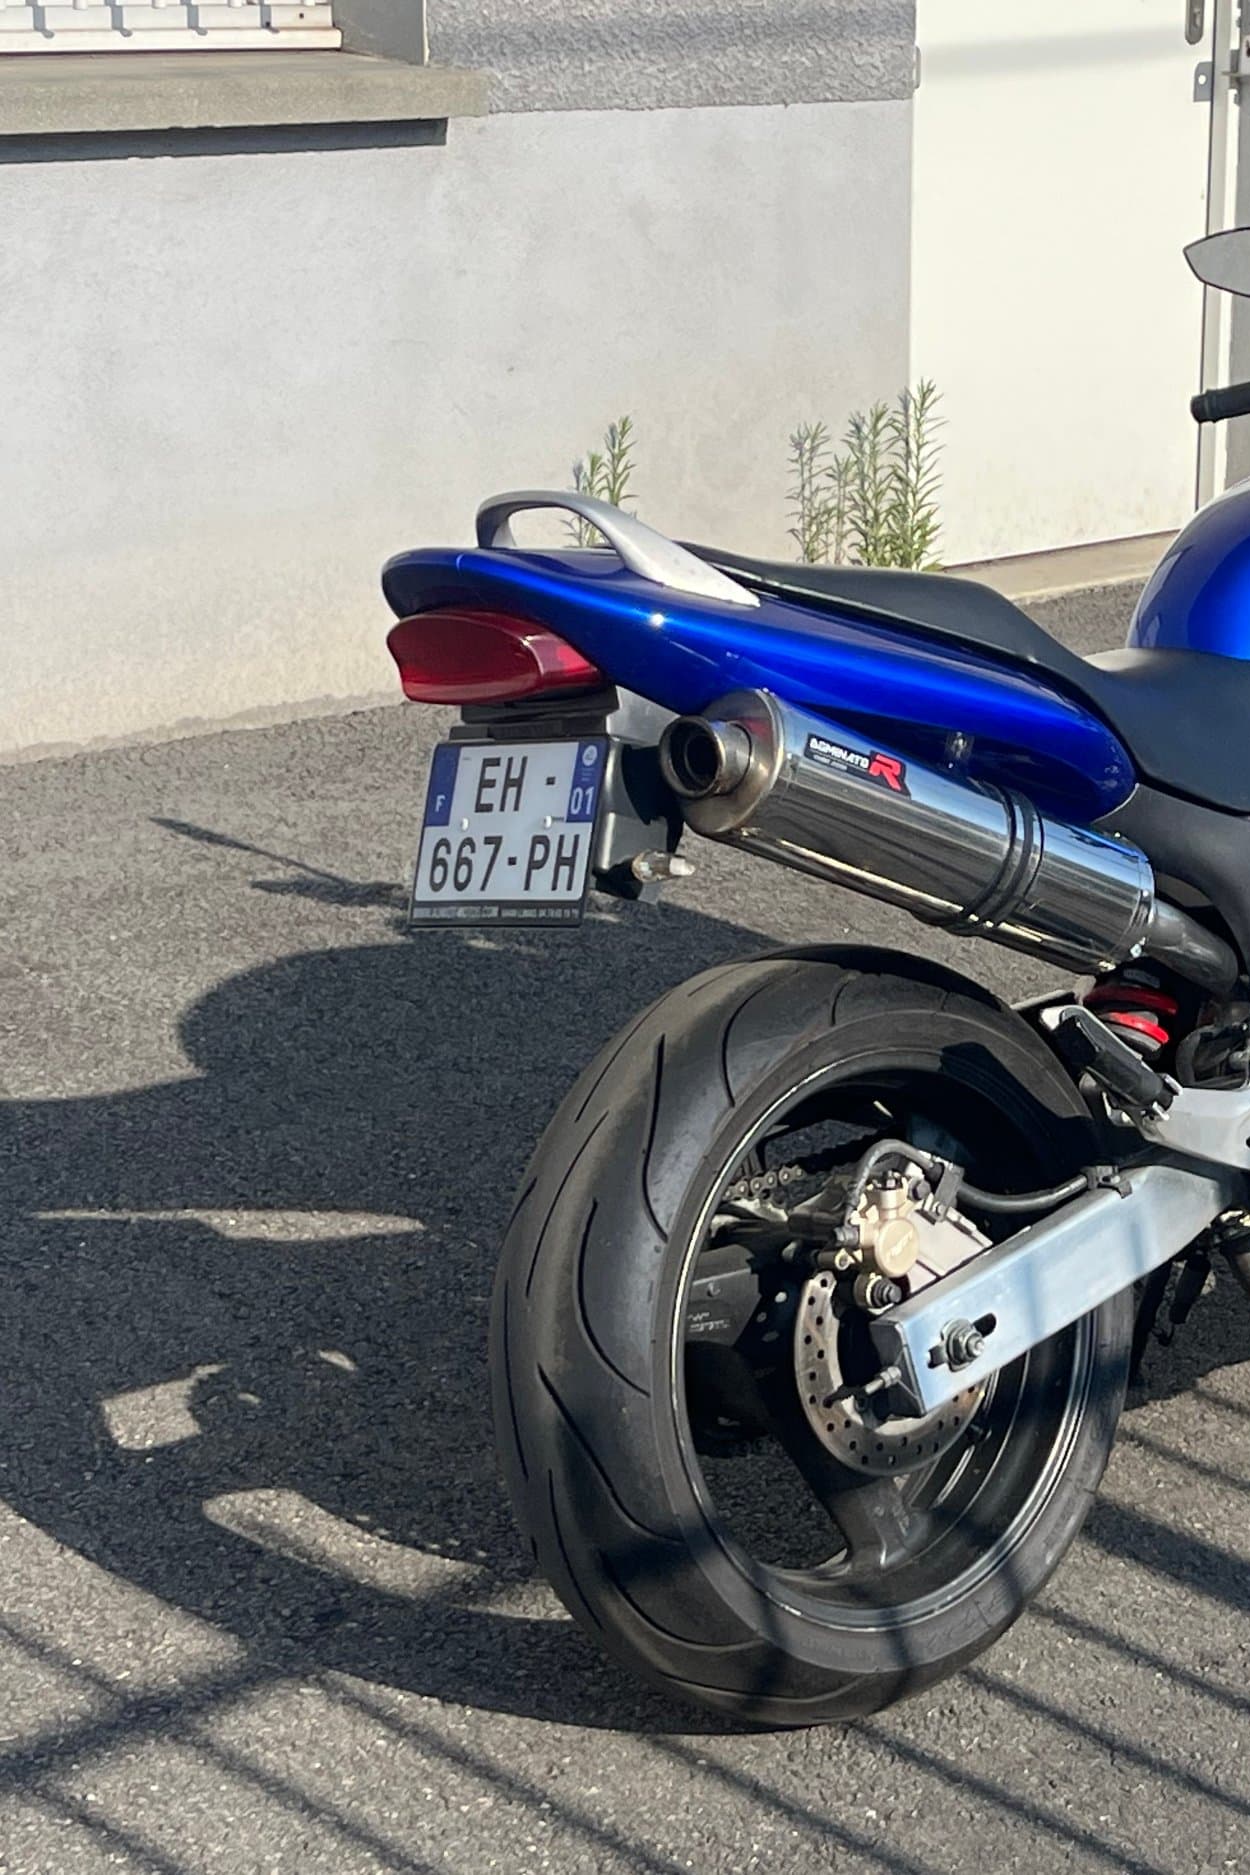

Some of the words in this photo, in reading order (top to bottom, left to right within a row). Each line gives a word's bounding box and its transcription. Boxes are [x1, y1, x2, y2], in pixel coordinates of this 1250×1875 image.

[434, 795, 446, 812] F
[570, 786, 594, 815] 01
[429, 834, 580, 892] 667-PH
